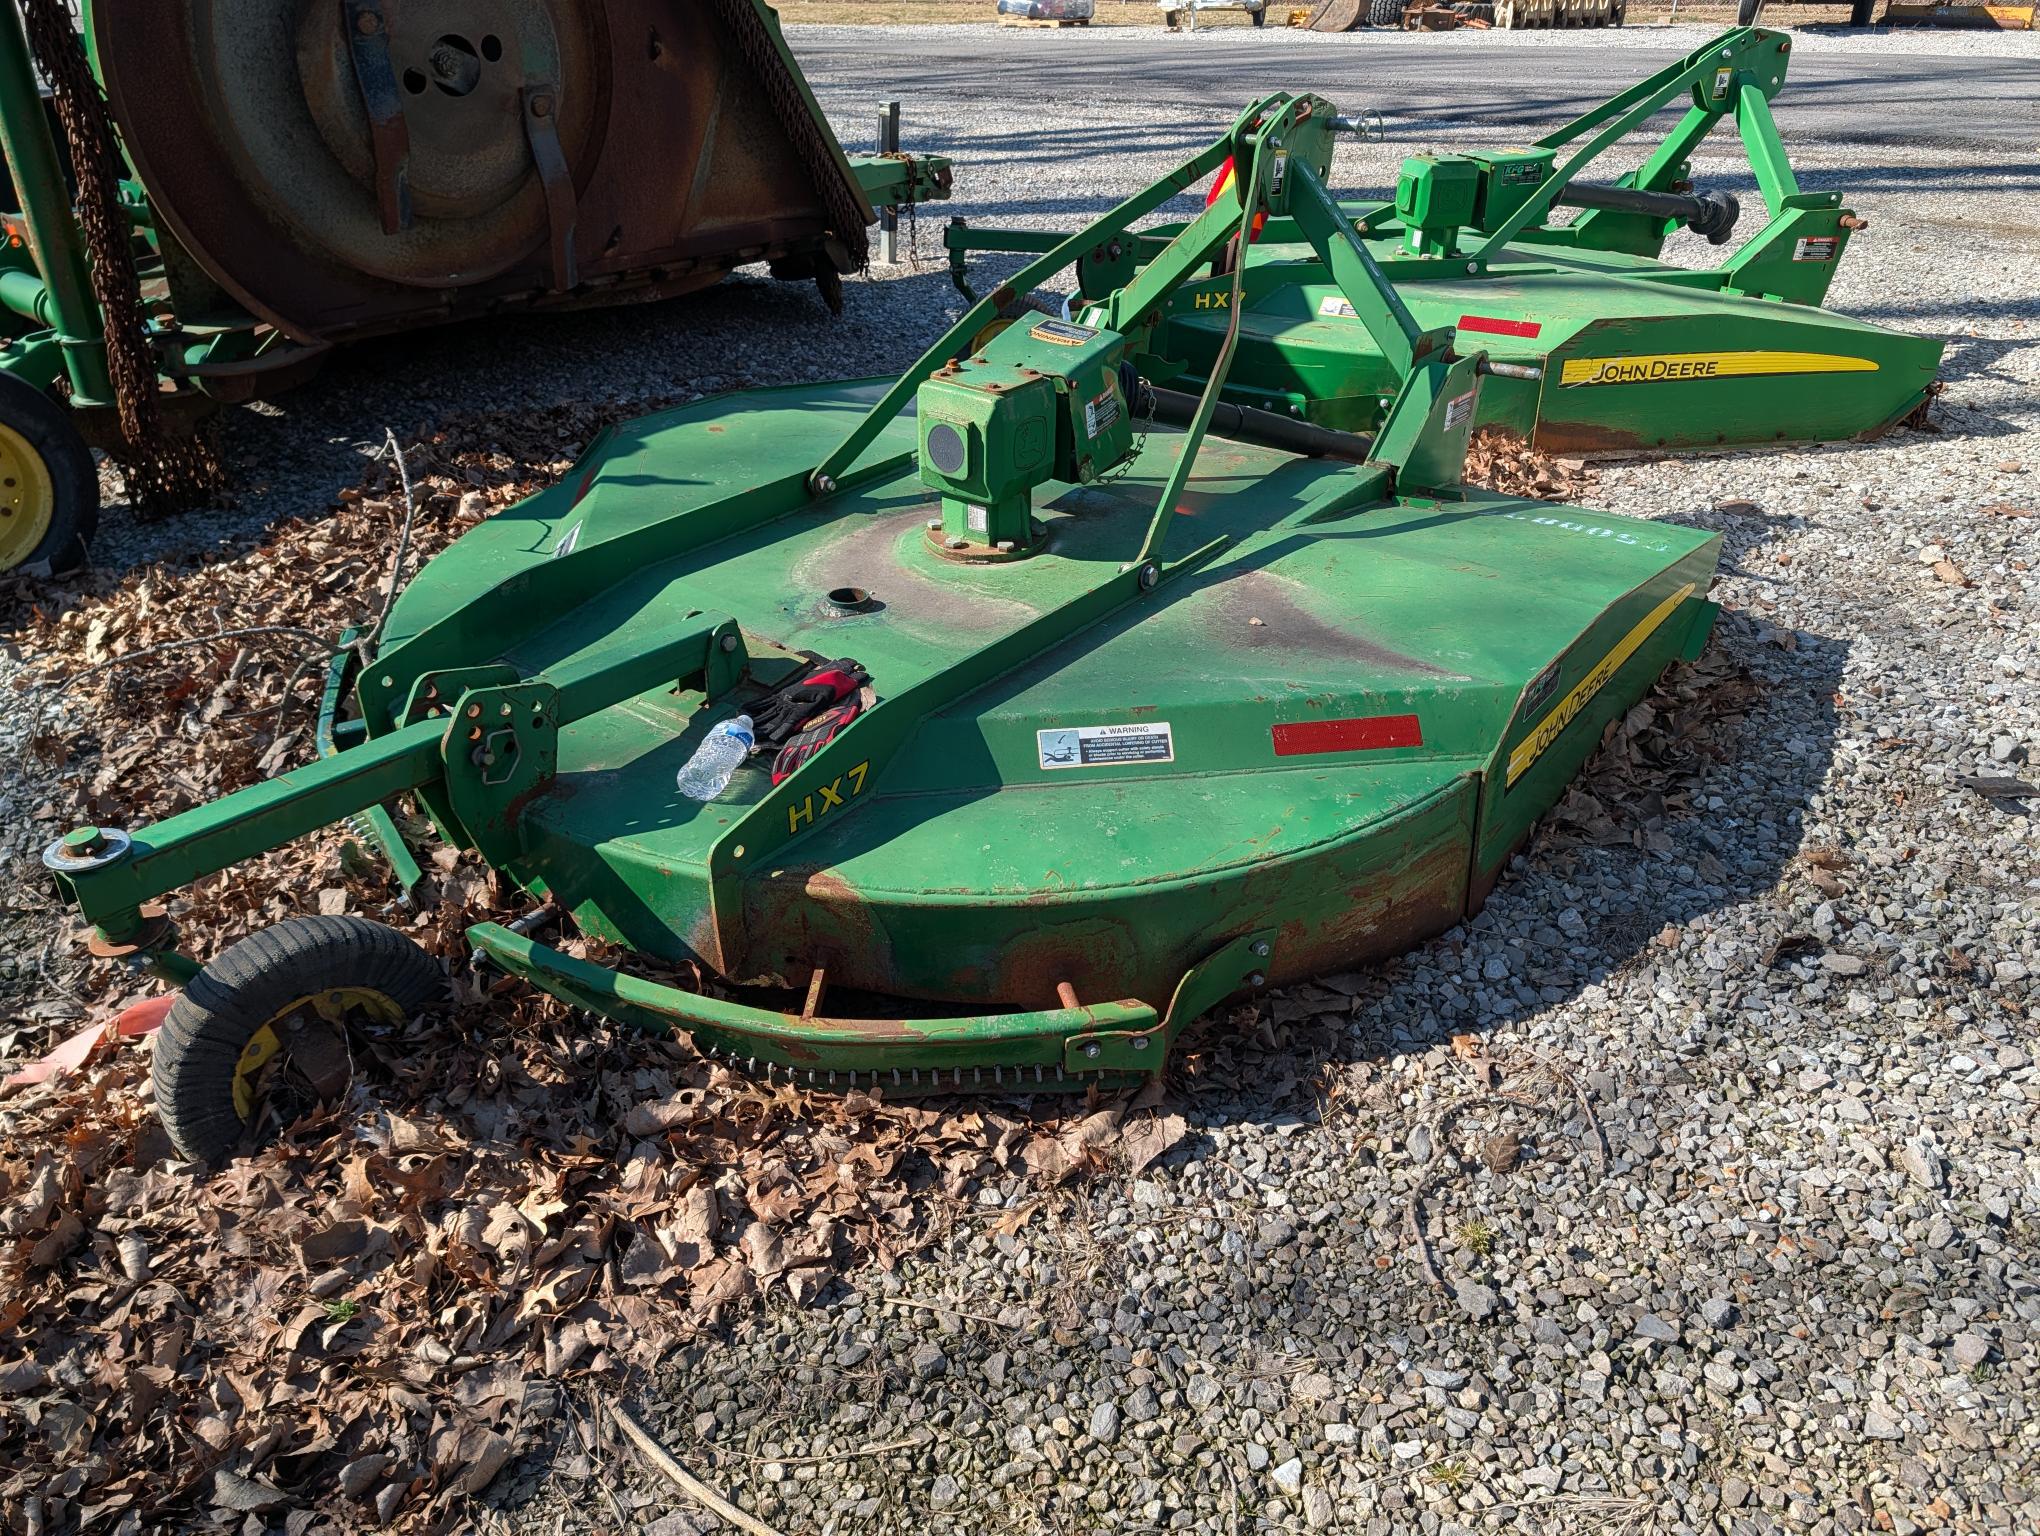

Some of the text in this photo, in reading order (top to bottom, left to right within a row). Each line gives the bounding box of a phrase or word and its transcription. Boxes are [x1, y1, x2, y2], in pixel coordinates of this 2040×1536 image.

[1592, 361, 1719, 380] JOHN DEERE
[1109, 726, 1149, 735] WARNING
[1529, 706, 1570, 764] JOHN
[1568, 662, 1612, 719] DEERE
[789, 760, 870, 834] HX7
